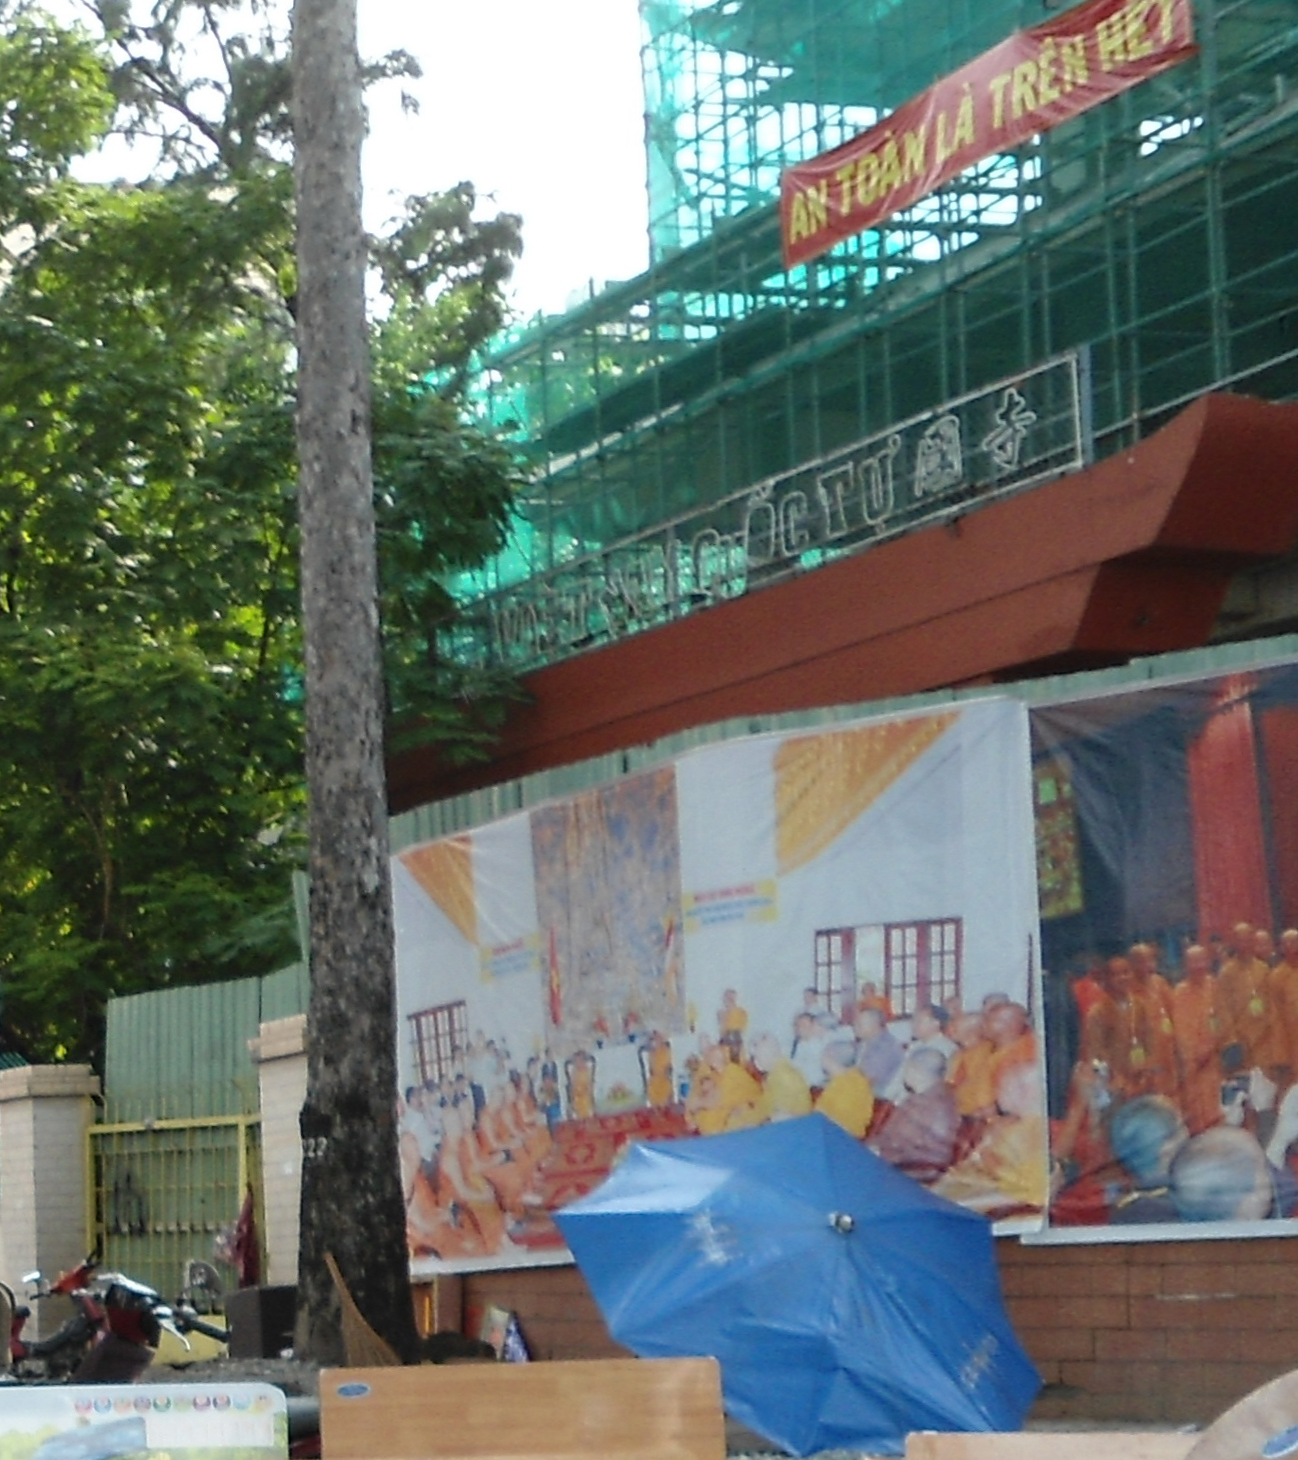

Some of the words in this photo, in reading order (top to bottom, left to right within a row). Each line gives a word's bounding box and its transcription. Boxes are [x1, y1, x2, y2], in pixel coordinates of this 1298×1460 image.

[790, 180, 829, 245] AN
[835, 128, 928, 216] TOÀN
[935, 83, 975, 164] LÀ
[989, 35, 1088, 128] TRÊN
